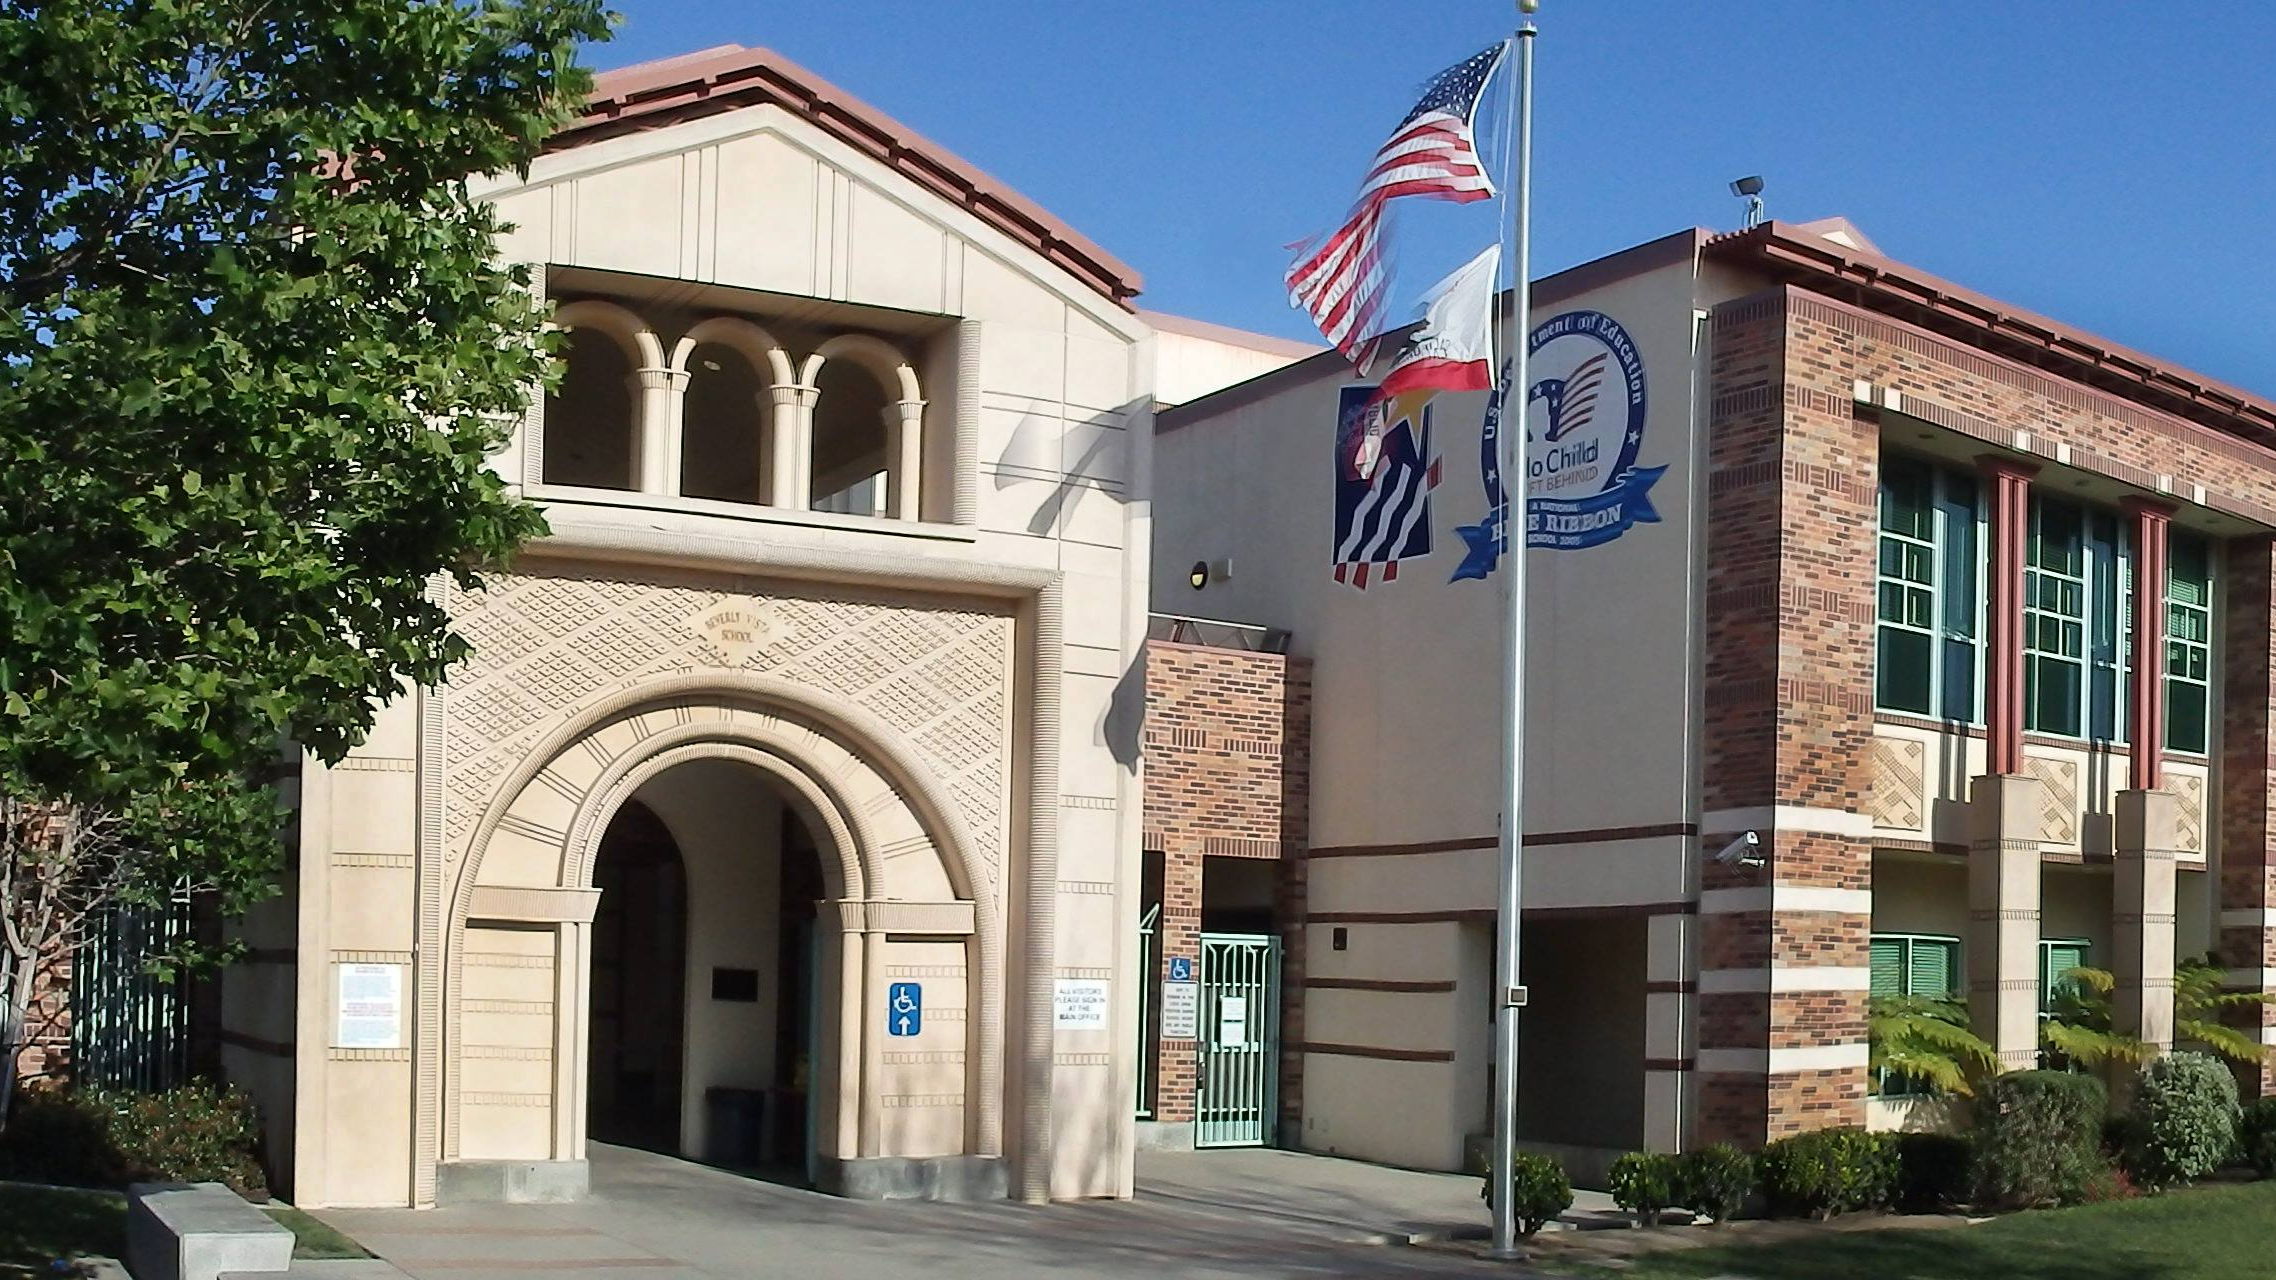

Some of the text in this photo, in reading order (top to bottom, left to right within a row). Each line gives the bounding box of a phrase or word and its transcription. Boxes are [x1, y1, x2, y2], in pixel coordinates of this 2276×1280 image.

[1578, 314, 1600, 331] of
[1600, 317, 1642, 405] Education
[1546, 438, 1599, 474] Child
[1546, 465, 1599, 492] BEHIND
[1545, 502, 1623, 533] RIBBON
